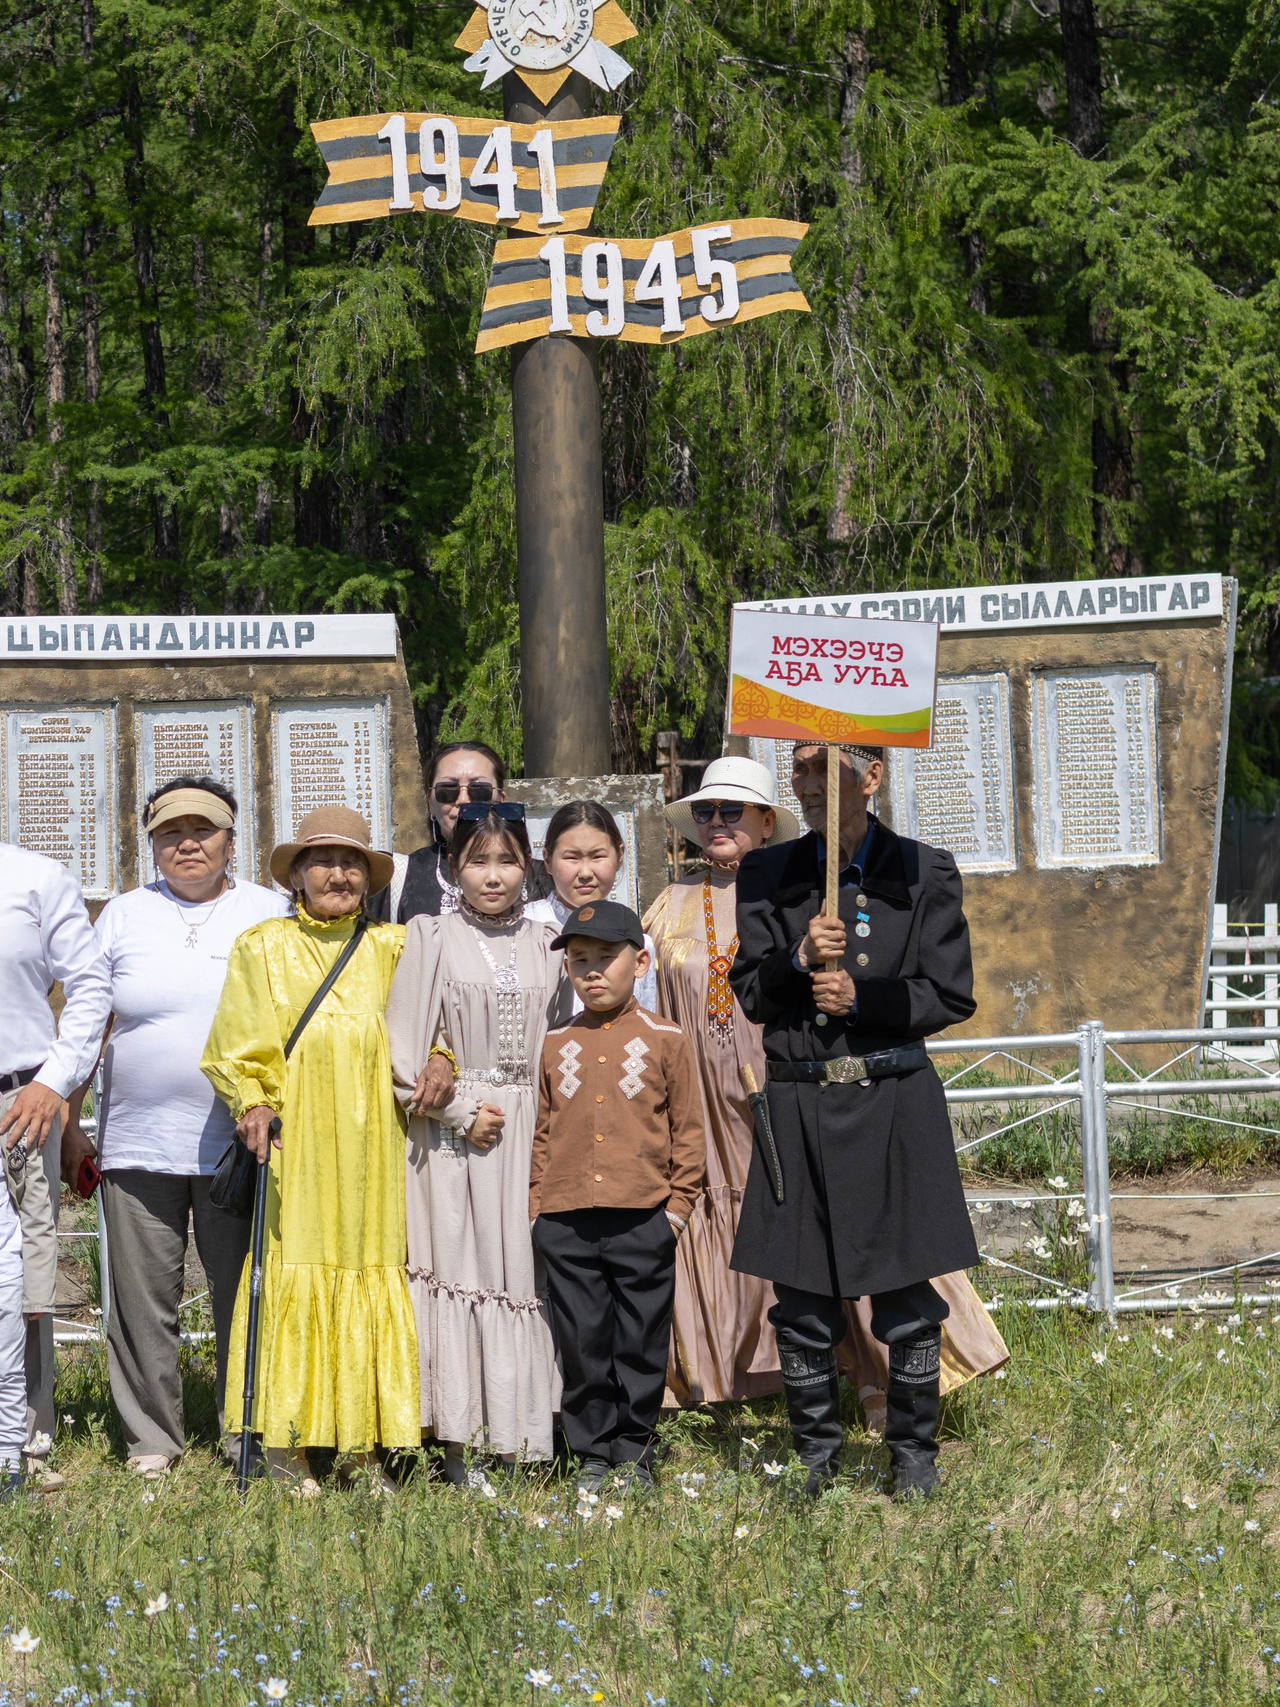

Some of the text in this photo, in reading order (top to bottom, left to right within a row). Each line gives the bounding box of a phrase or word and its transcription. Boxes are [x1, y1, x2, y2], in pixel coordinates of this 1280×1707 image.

[491, 0, 521, 56] ОТЕЧЕ
[377, 114, 565, 226] 1941
[539, 225, 740, 338] 1945
[860, 595, 966, 623] СЭРИИ
[981, 581, 1210, 622] СЫЛЛАРЫГАР
[7, 620, 315, 651] ЦЫПАНДИННАР
[771, 635, 904, 663] МЭХЭЭЧЭ
[290, 732, 338, 740] ЦЫПАНДИН
[291, 758, 344, 766] ЦЫПАНДИНА
[291, 776, 345, 784] ЦЫПАНДИНА
[291, 785, 346, 794] ЦЫПАНДИНА
